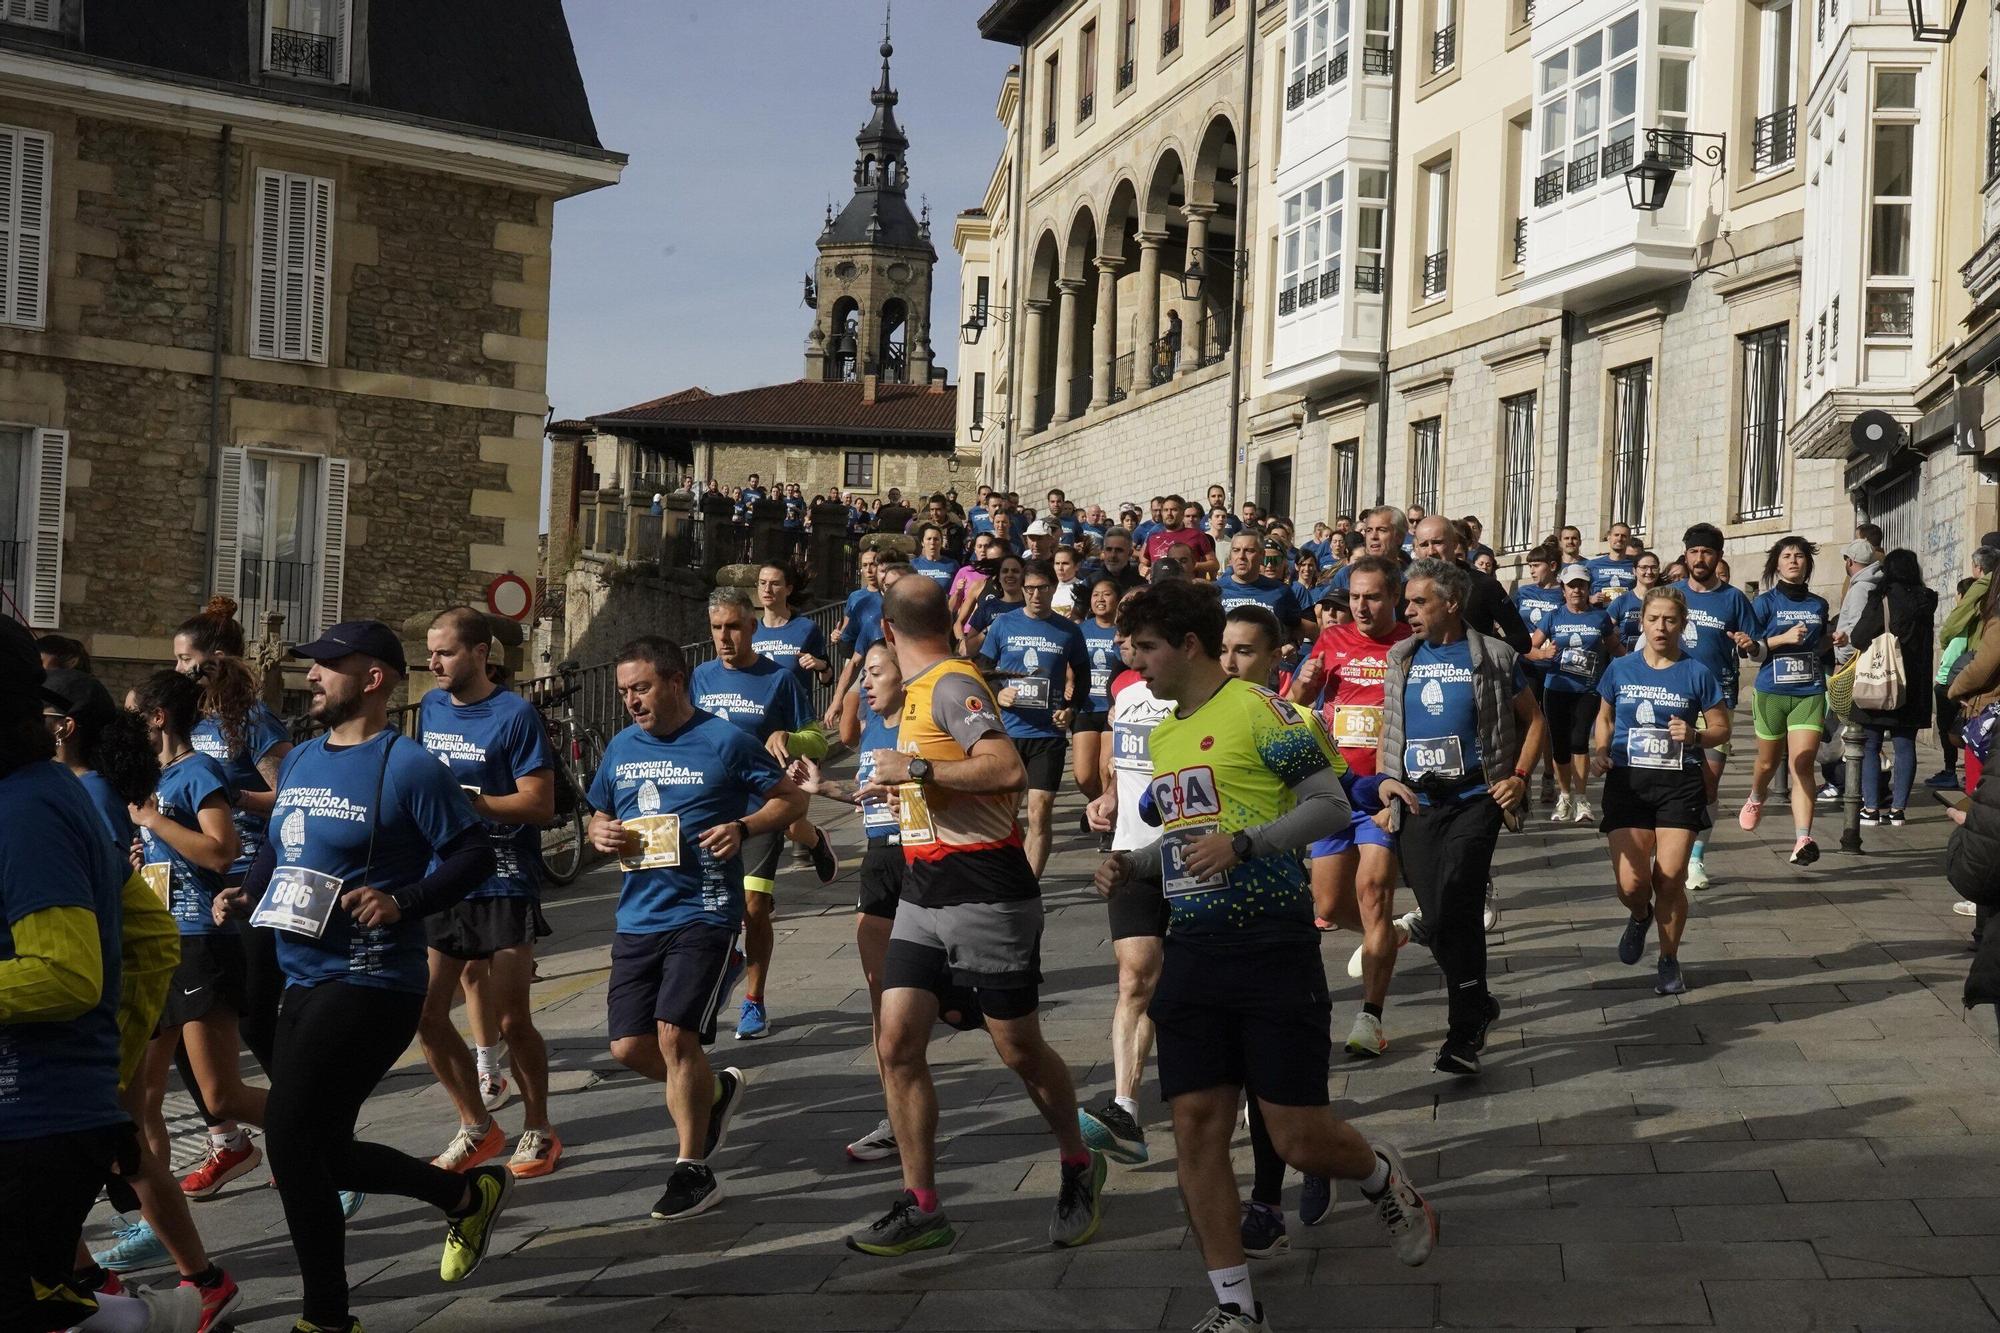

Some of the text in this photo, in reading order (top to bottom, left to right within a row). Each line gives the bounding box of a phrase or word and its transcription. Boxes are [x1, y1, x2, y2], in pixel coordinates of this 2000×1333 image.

[1016, 640, 1056, 648] ALMENDRA
[1572, 654, 1588, 666] 972
[1786, 660, 1804, 672] 738
[1412, 662, 1454, 671] CONQUISTA
[1362, 668, 1386, 678] TRA
[1412, 668, 1471, 678] ALMENDRA
[1091, 676, 1108, 686] 102
[1018, 684, 1038, 696] 398
[1627, 684, 1666, 692] CONQUISTA
[1626, 690, 1680, 702] ALMENDRA
[704, 699, 754, 708] ALMENDRA
[1654, 700, 1690, 708] KONKISTA
[729, 706, 764, 715] KONKISTA
[1346, 716, 1374, 732] 563
[428, 732, 464, 742] CONQUISTA
[426, 740, 476, 752] ALMENDRA
[1122, 734, 1144, 754] 861
[1644, 738, 1669, 754] 768
[450, 751, 486, 762] KONKISTA
[1416, 748, 1446, 766] 830
[616, 760, 672, 772] LA CONQUISTA
[624, 767, 690, 780] ALMENDRA
[658, 776, 704, 785] KONKISTA
[284, 788, 332, 797] CONQUISTA
[280, 796, 367, 812] ALMENDRA REN
[308, 808, 366, 822] KONKISTA
[272, 881, 313, 909] 886
